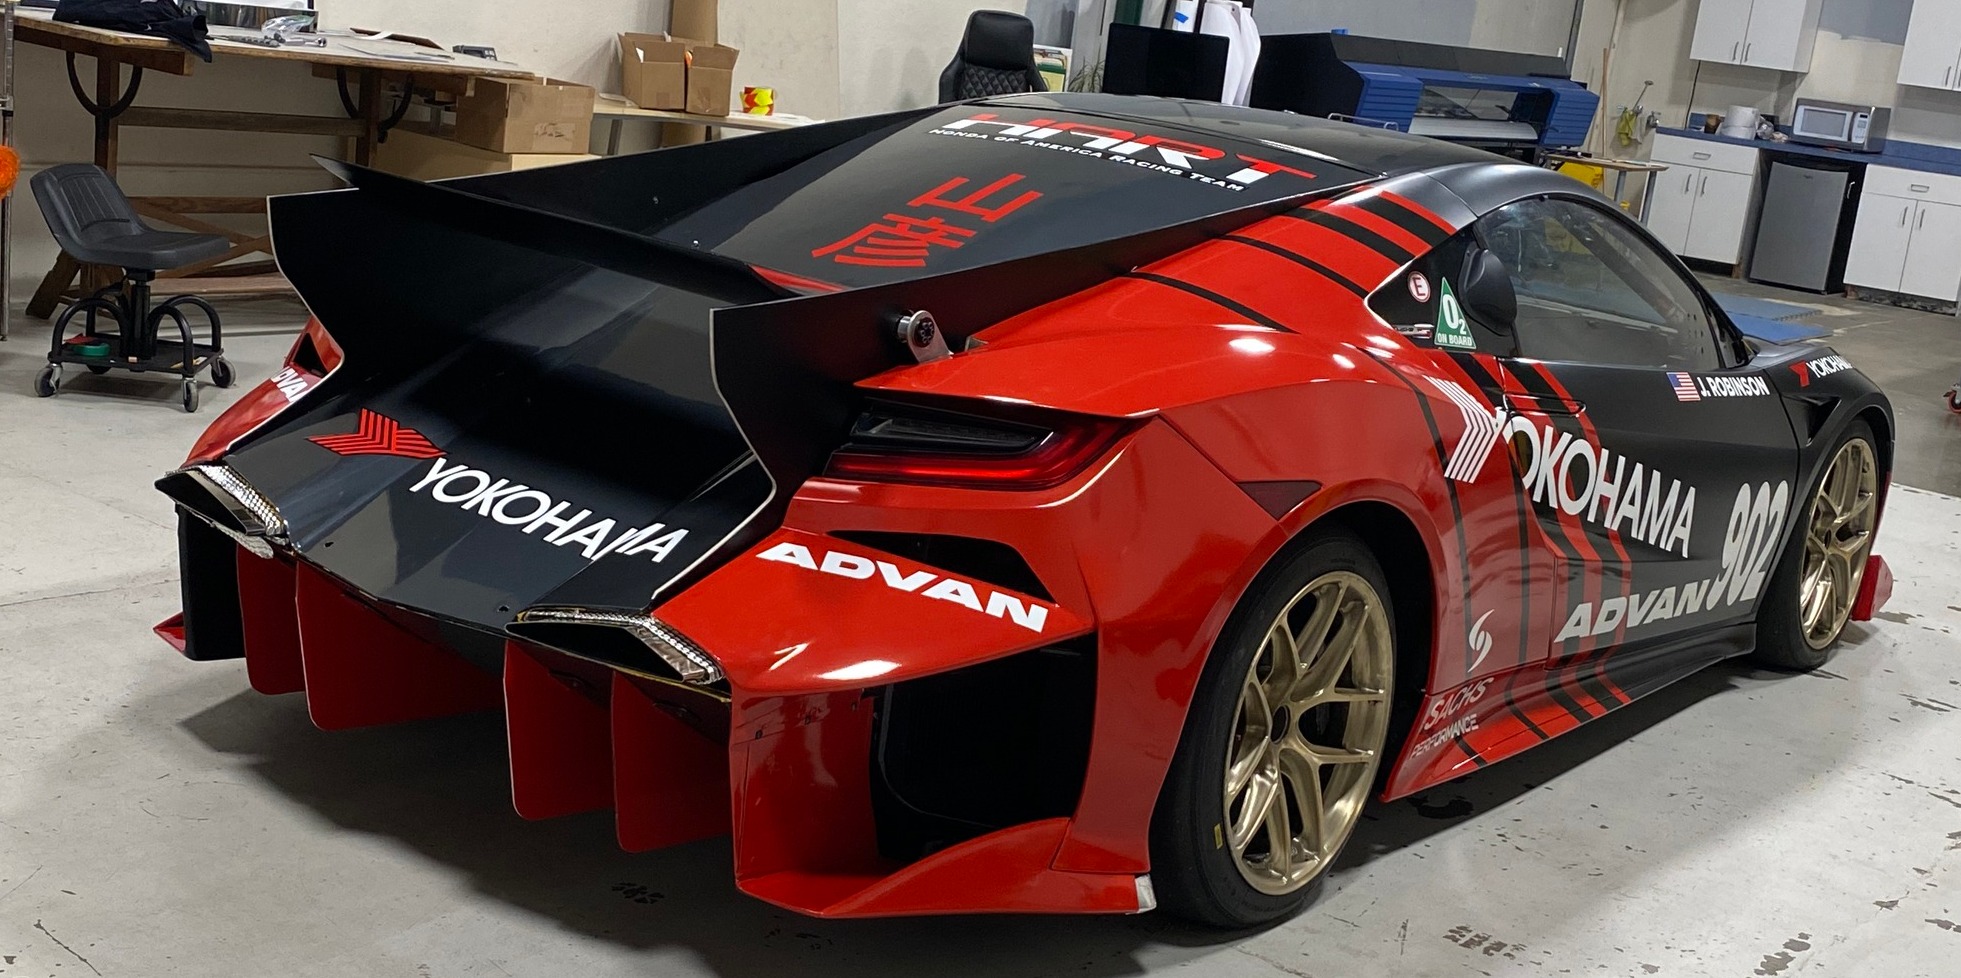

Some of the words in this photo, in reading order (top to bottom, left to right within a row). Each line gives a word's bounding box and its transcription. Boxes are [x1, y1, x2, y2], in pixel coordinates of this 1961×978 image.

[929, 129, 989, 139] HONDA
[1020, 140, 1102, 158] AMERICA
[1109, 154, 1183, 176] RACING
[1191, 172, 1244, 192] TEAM
[941, 113, 1317, 184] HART
[1437, 333, 1448, 344] ON
[1448, 335, 1473, 347] BOARD
[1806, 355, 1852, 378] YOKOHA
[270, 365, 310, 402] DVA
[1696, 376, 1711, 398] J.
[1709, 376, 1770, 397] ROBINSON
[408, 456, 690, 563] YOKOHAMA
[1705, 479, 1789, 611] 902
[755, 541, 1049, 633] ADVAN
[1554, 579, 1710, 643] ADVAN
[1423, 677, 1495, 731] SACHS
[1410, 713, 1480, 759] PERFORMANCE
